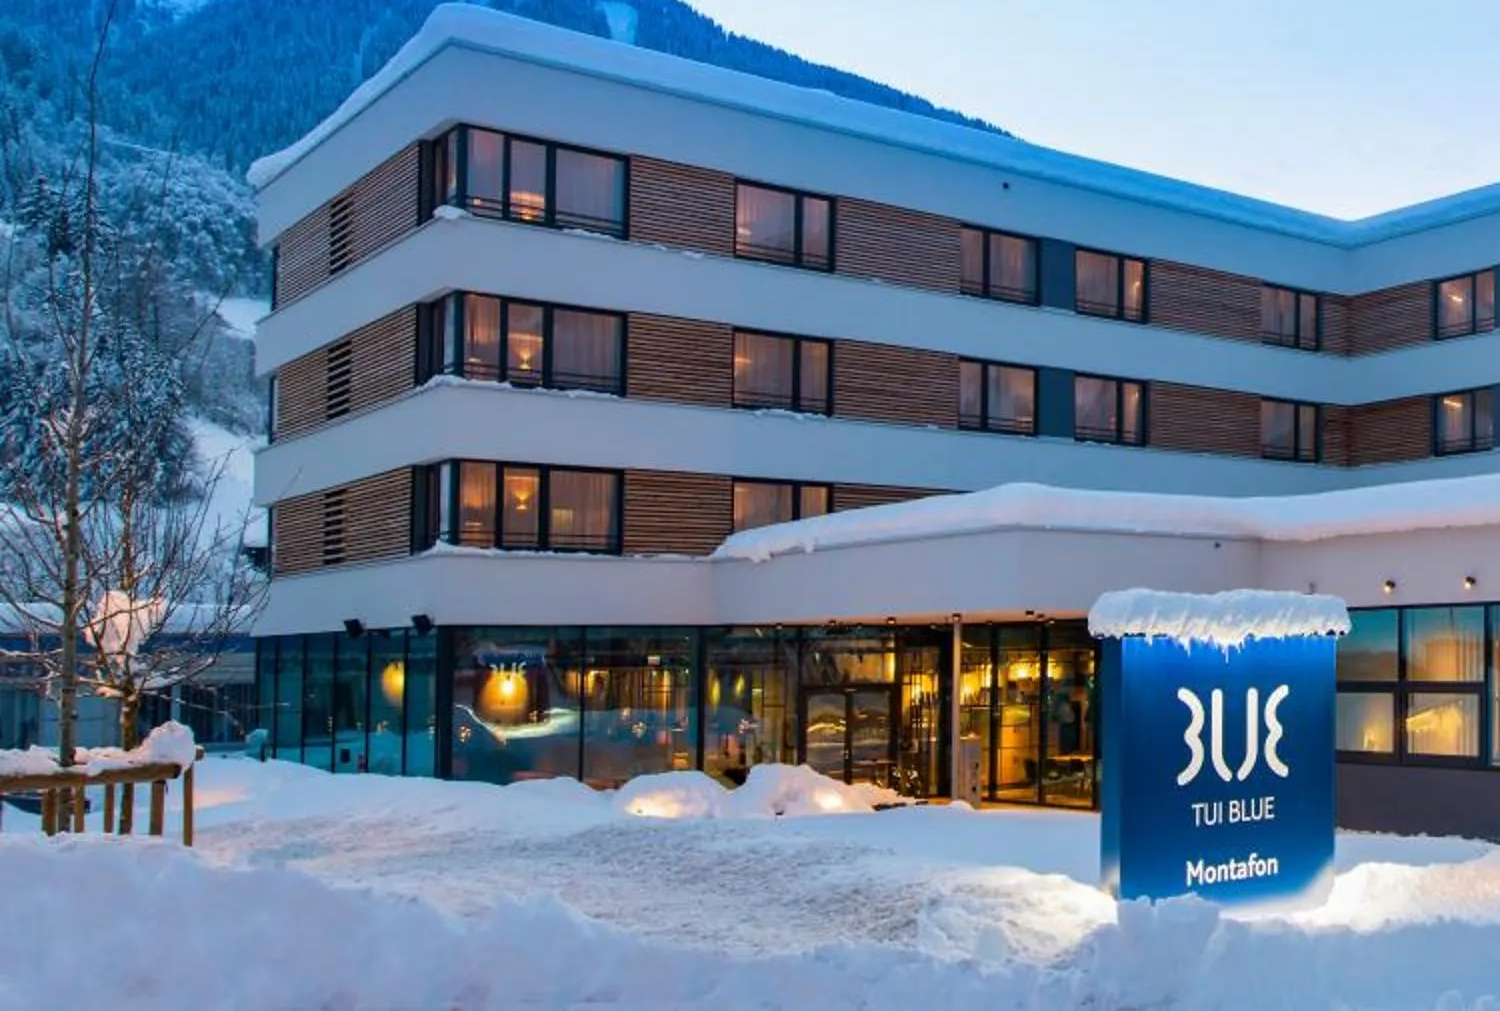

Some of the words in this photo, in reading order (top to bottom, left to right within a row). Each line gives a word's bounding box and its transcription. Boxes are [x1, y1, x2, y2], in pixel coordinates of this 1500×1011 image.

[1192, 800, 1223, 827] TUI
[1229, 796, 1275, 823] BLUE
[1185, 852, 1278, 886] Montafon
